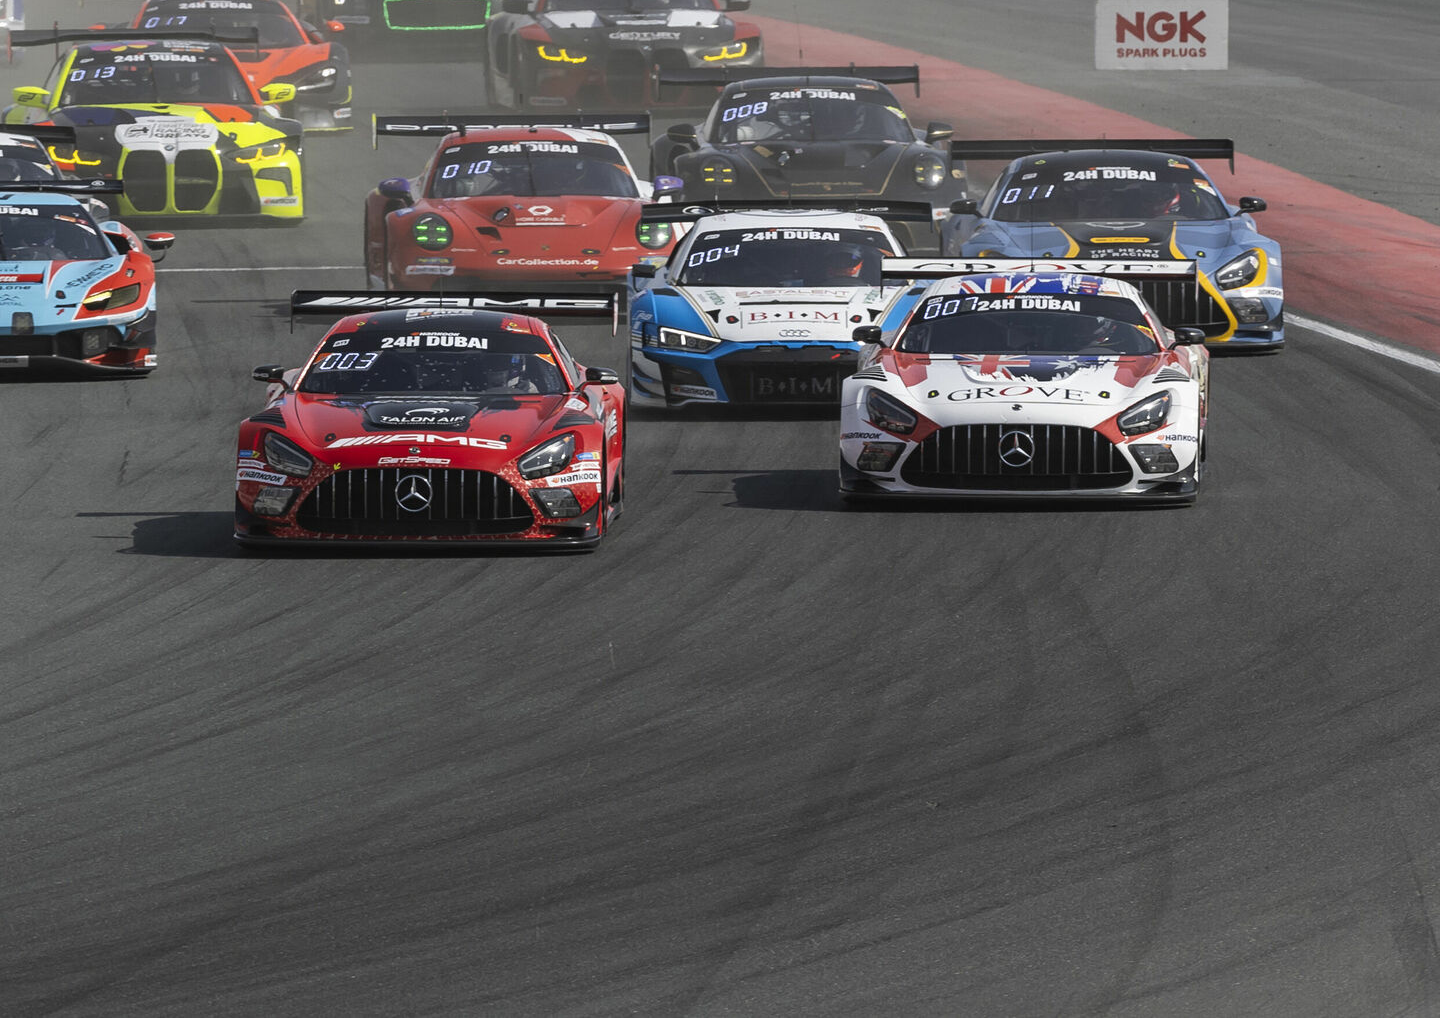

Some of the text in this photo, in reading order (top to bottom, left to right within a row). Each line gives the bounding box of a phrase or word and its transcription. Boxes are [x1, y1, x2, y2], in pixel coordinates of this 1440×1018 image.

[144, 16, 187, 29] 017
[1115, 10, 1208, 44] NGK
[114, 54, 196, 63] 24H DUBAI
[1116, 47, 1207, 59] SPARK PLUGS
[70, 66, 115, 81] 013
[770, 91, 856, 100] 24H DUBAI
[722, 102, 768, 122] 008
[488, 143, 578, 154] 24H DUBAI
[442, 160, 492, 179] 010
[1063, 170, 1156, 181] 24H DUBAI
[1002, 185, 1054, 204] 011
[742, 231, 840, 242] 24H DUBAI
[496, 258, 599, 267] CarCollection.de
[688, 245, 740, 267] 004
[736, 289, 850, 298] EASTALENT
[923, 297, 977, 320] 007
[977, 298, 1081, 312] 24H DUBAI
[381, 336, 488, 349] 24H DUBAI
[320, 352, 379, 371] 003
[948, 386, 1084, 402] GROVE
[382, 434, 508, 449] AMG
